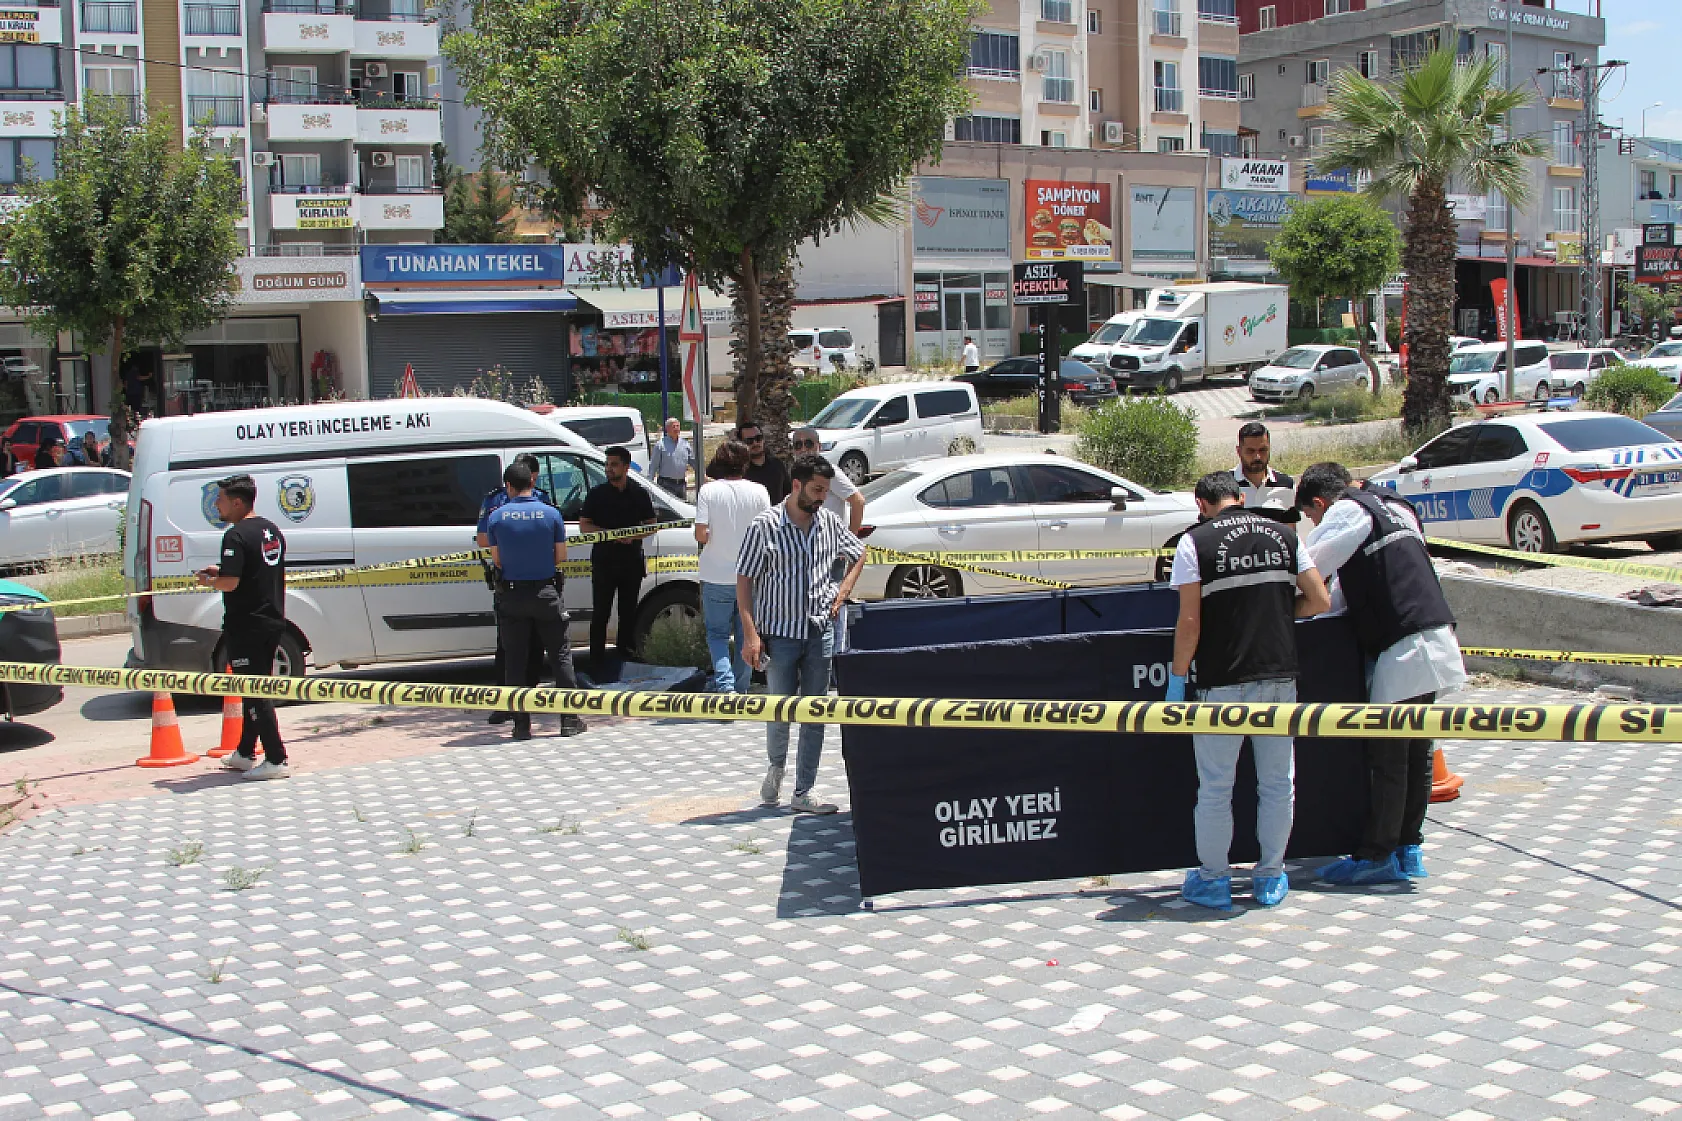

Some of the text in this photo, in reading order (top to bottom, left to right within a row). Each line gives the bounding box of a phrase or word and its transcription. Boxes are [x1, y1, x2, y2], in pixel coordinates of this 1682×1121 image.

[1240, 163, 1284, 176] AKANA
[1037, 185, 1100, 205] ŞAMPİYON
[386, 254, 545, 272] TUNAHAN TEKEL
[1024, 264, 1058, 279] ASEL
[256, 274, 345, 289] DOĞUM GÜNÜ
[236, 423, 275, 440] OLAY
[1415, 494, 1448, 520] OLİS
[160, 538, 179, 551] 112
[1229, 548, 1282, 571] POLİS
[934, 785, 1062, 823] OLAY YERİ
[939, 818, 1059, 848] GİRİLMEZ
